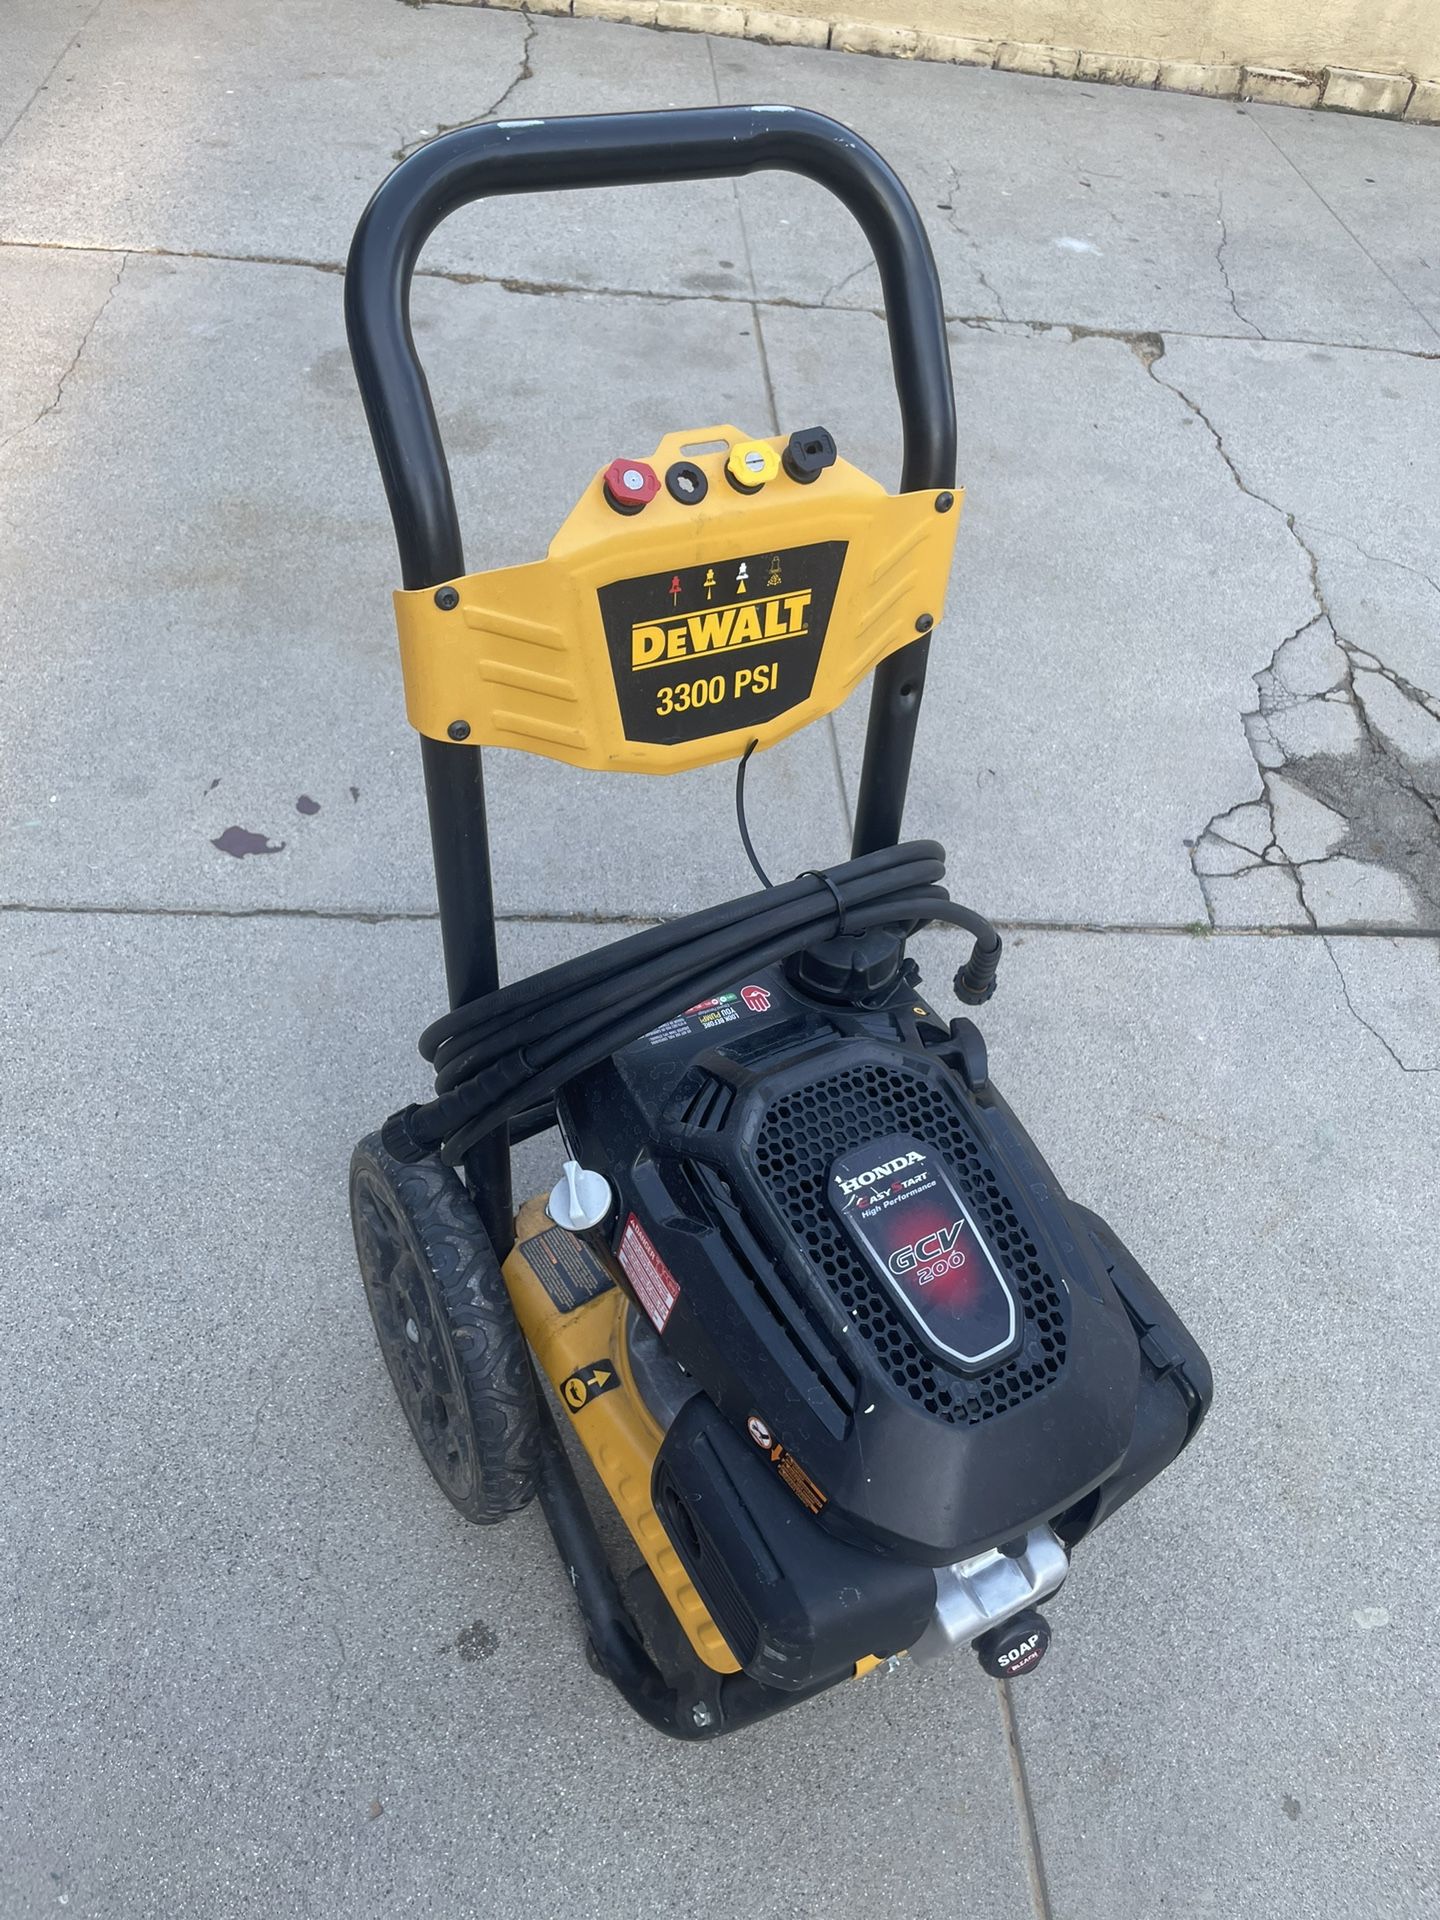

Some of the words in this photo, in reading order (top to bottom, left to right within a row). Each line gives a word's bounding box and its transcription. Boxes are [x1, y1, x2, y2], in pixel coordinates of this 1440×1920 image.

[656, 675, 726, 716] 3300
[734, 662, 779, 698] PSI
[702, 1017, 725, 1029] BEFORE
[720, 1007, 736, 1017] YOU
[724, 1012, 740, 1022] LOOK
[839, 1151, 926, 1195] HONDA
[861, 1205, 882, 1218] High
[883, 1180, 937, 1209] Performance
[635, 1225, 656, 1260] DANGER
[889, 1219, 965, 1275] GCV
[916, 1251, 966, 1286] 200
[998, 1635, 1039, 1667] SOAP
[1011, 1652, 1039, 1671] BLEACH
